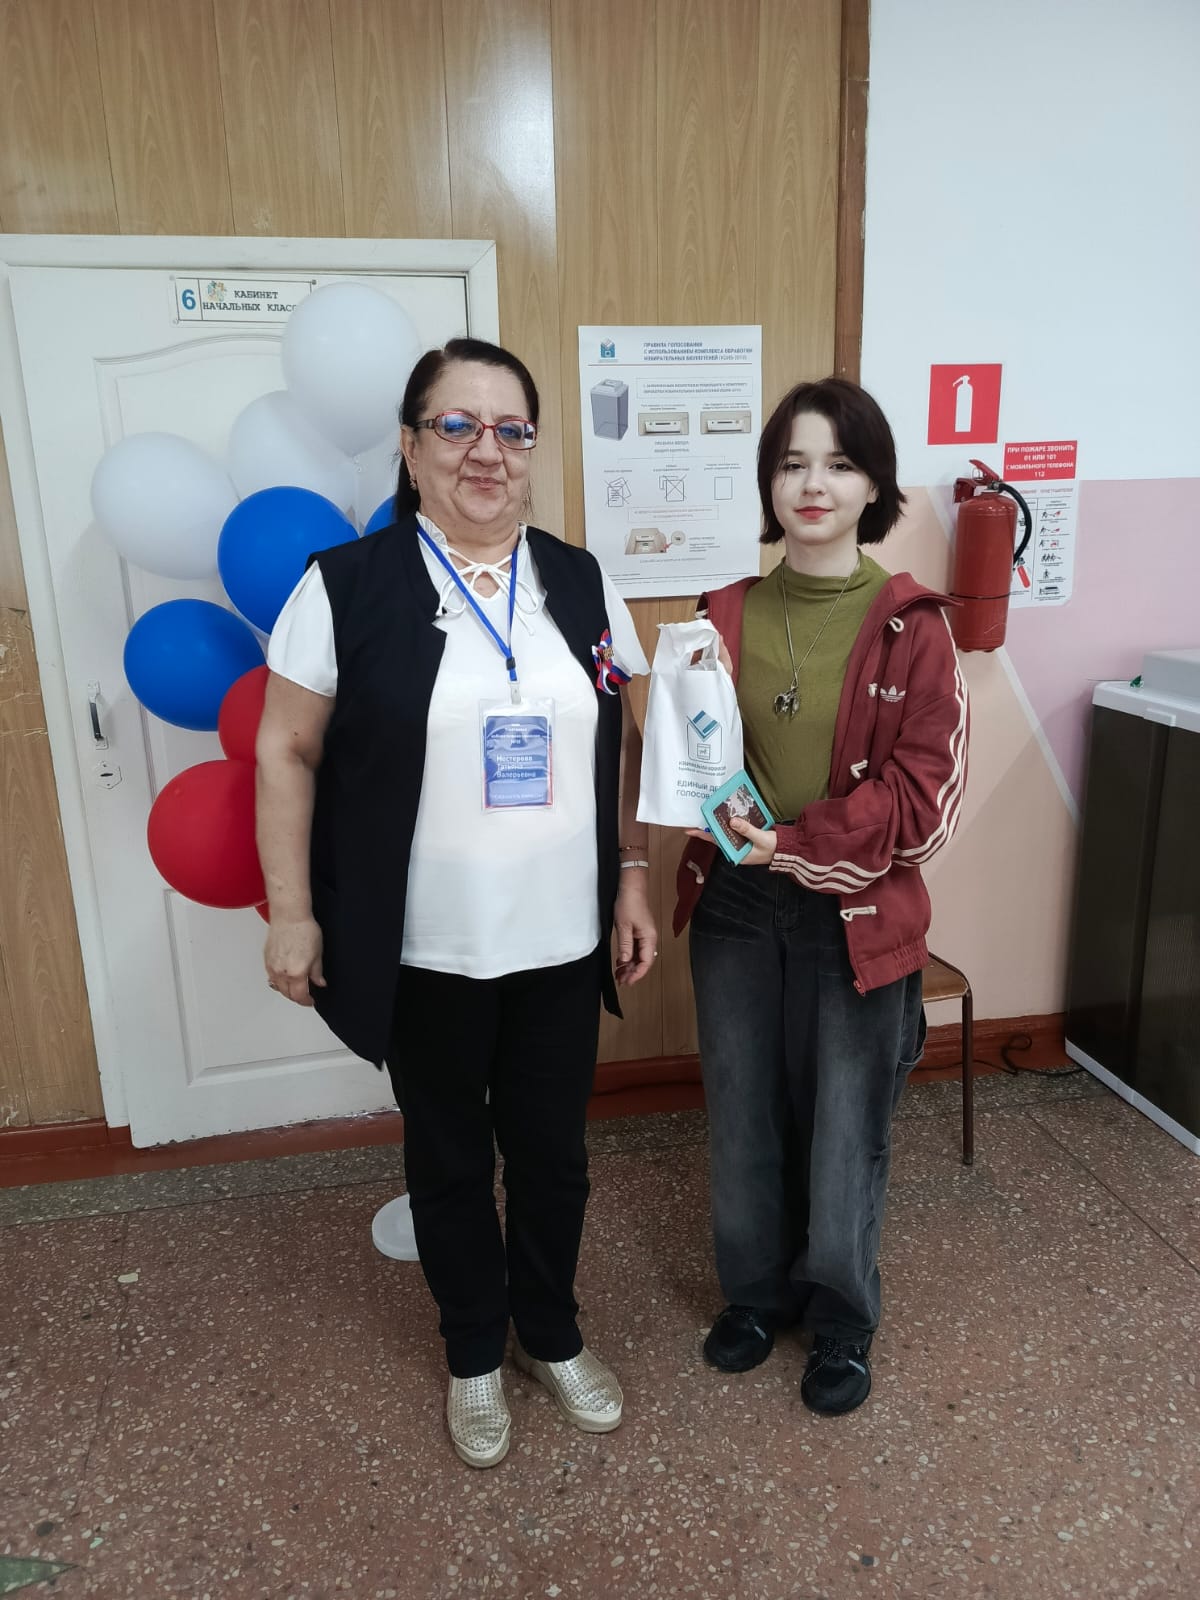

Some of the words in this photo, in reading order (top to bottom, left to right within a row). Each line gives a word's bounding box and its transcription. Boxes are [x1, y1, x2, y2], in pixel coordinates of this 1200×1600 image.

[181, 288, 196, 310] 6
[234, 290, 279, 299] КАБИНЕТ
[202, 302, 261, 311] НАЧАЛЬНЫХ
[677, 780, 708, 791] ЕДИНЫЙ
[709, 784, 721, 793] ДЕ
[676, 789, 713, 800] ГОЛОСОВ
